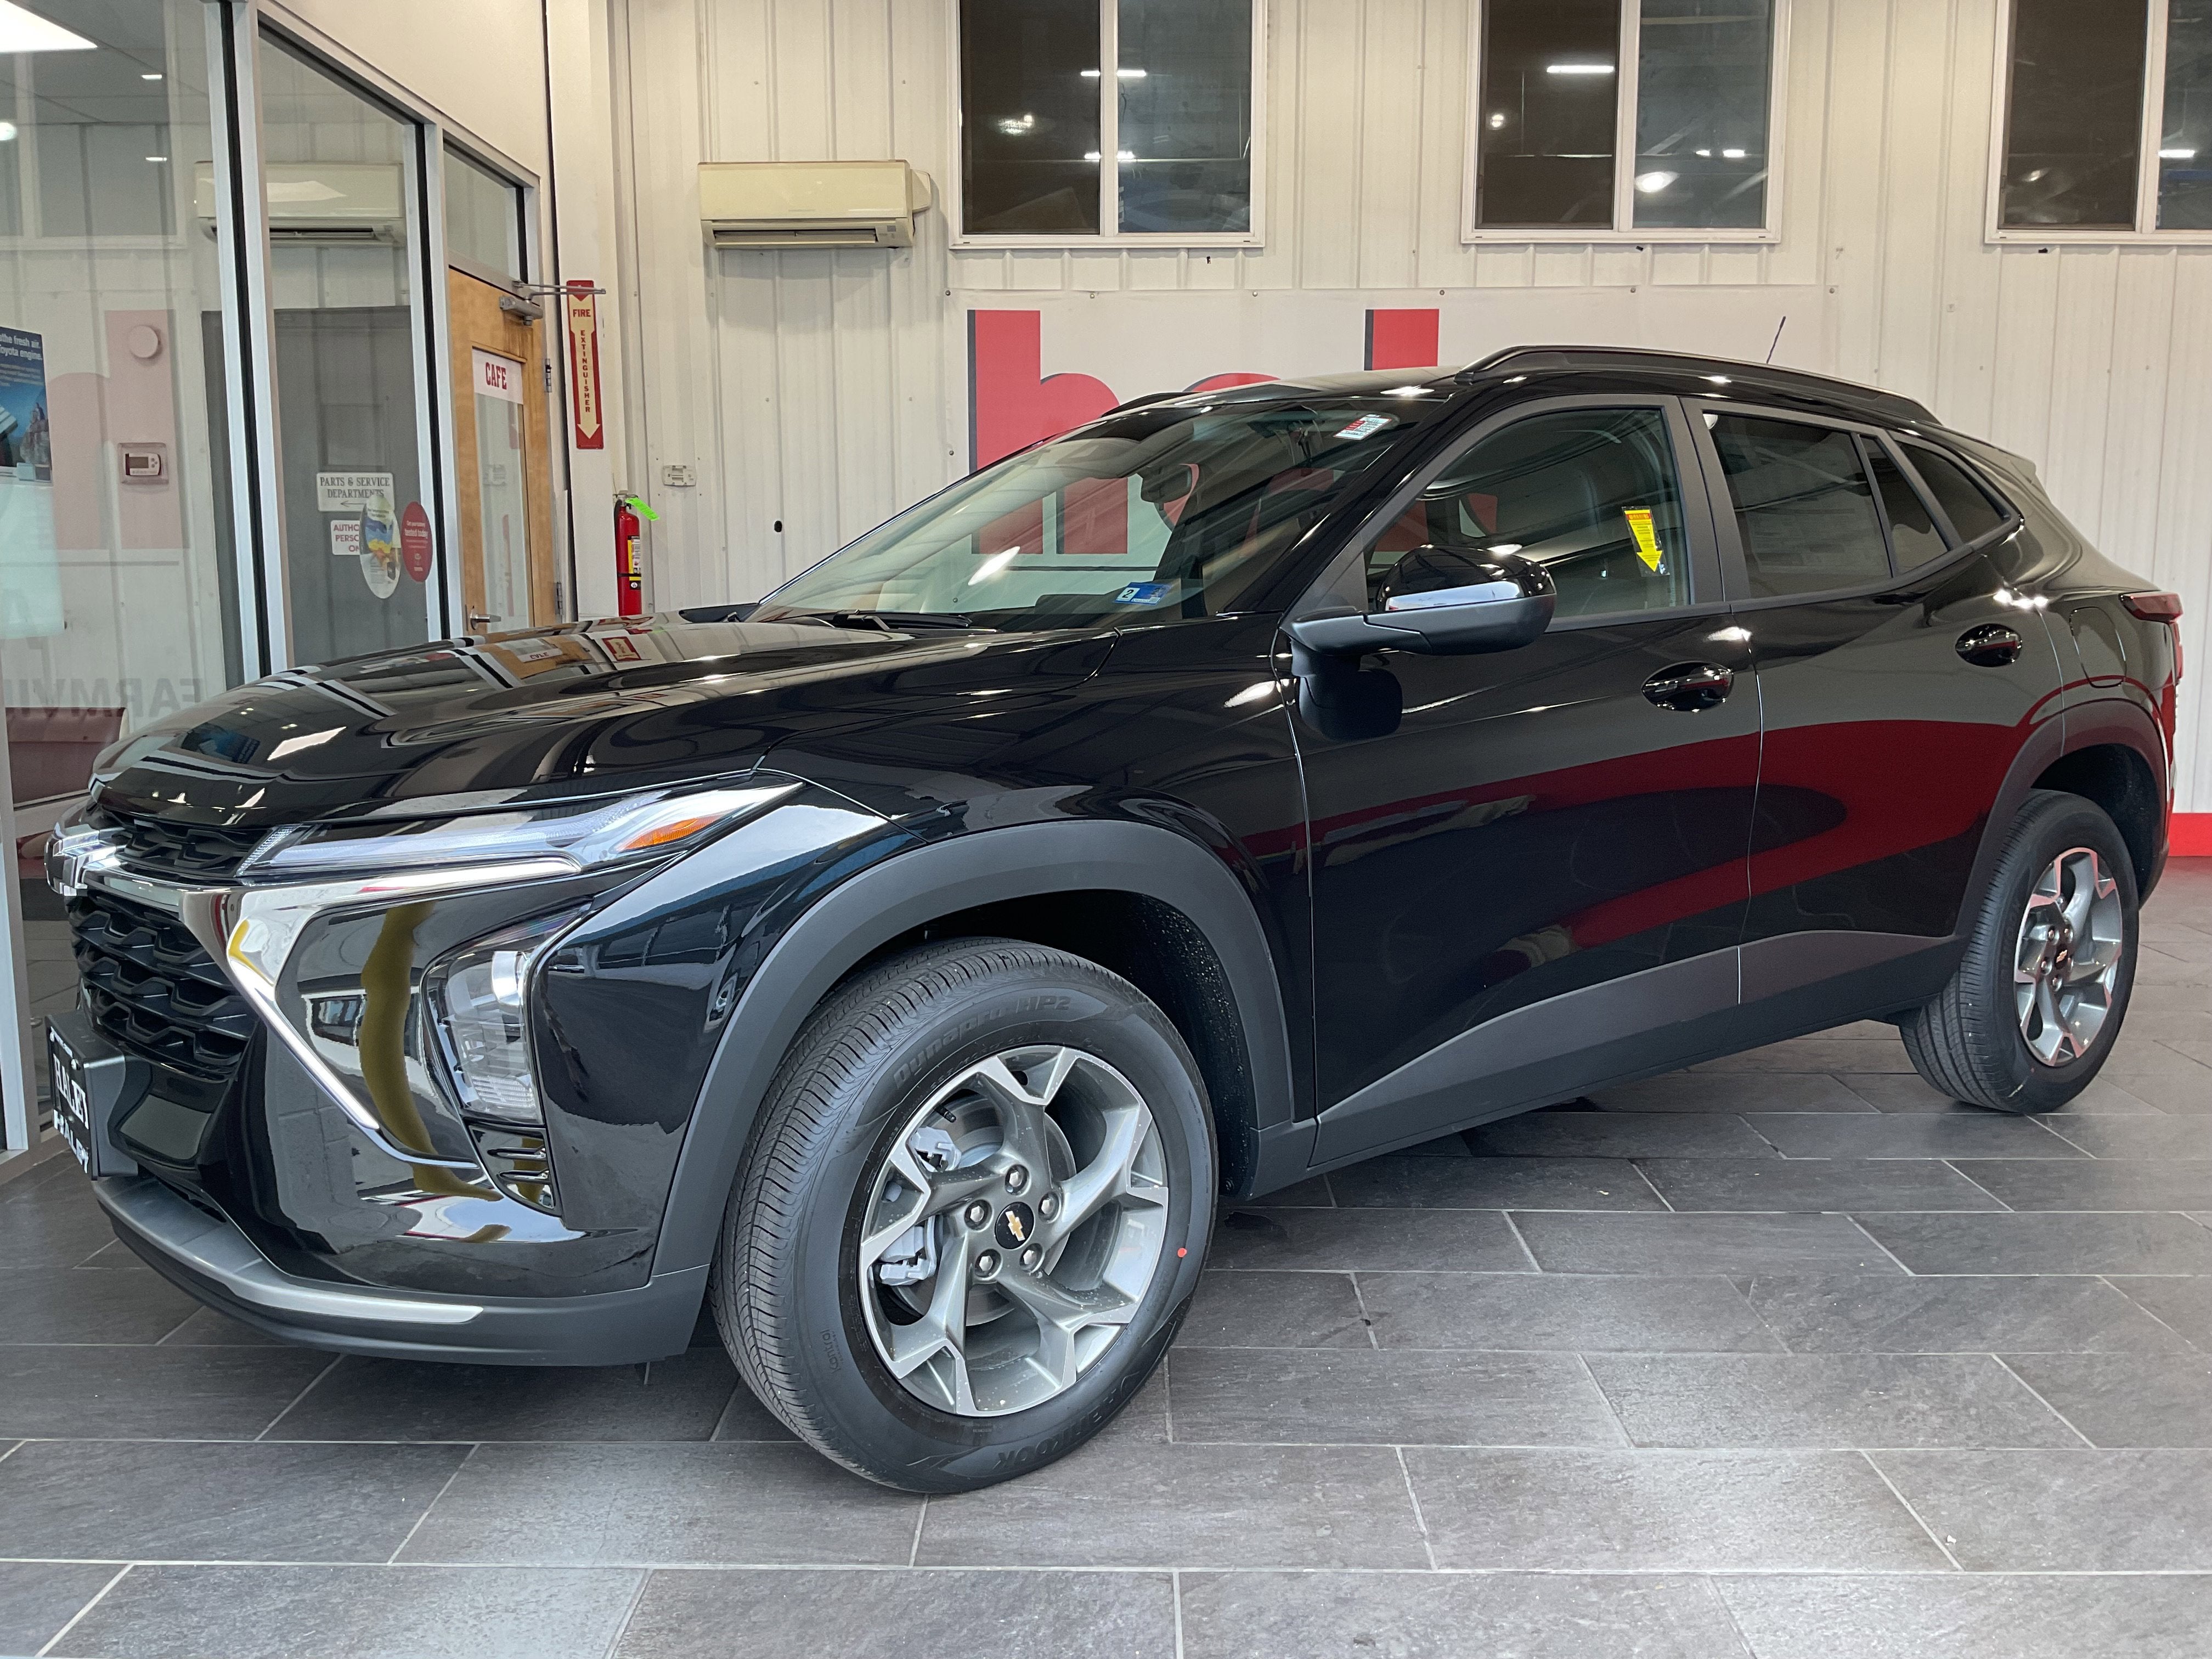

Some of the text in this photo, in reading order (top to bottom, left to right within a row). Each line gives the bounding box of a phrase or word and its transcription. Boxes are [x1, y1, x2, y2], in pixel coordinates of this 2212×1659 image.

[573, 309, 591, 317] FIRE
[486, 362, 507, 390] CAFE
[580, 330, 590, 413] EXTINGUISHER
[320, 477, 390, 487] PARTS & SERVICE
[327, 489, 384, 498] DEPARTMENTS
[1122, 589, 1134, 598] 2
[1015, 995, 1071, 1014] HP2
[54, 1109, 89, 1174] HALEY
